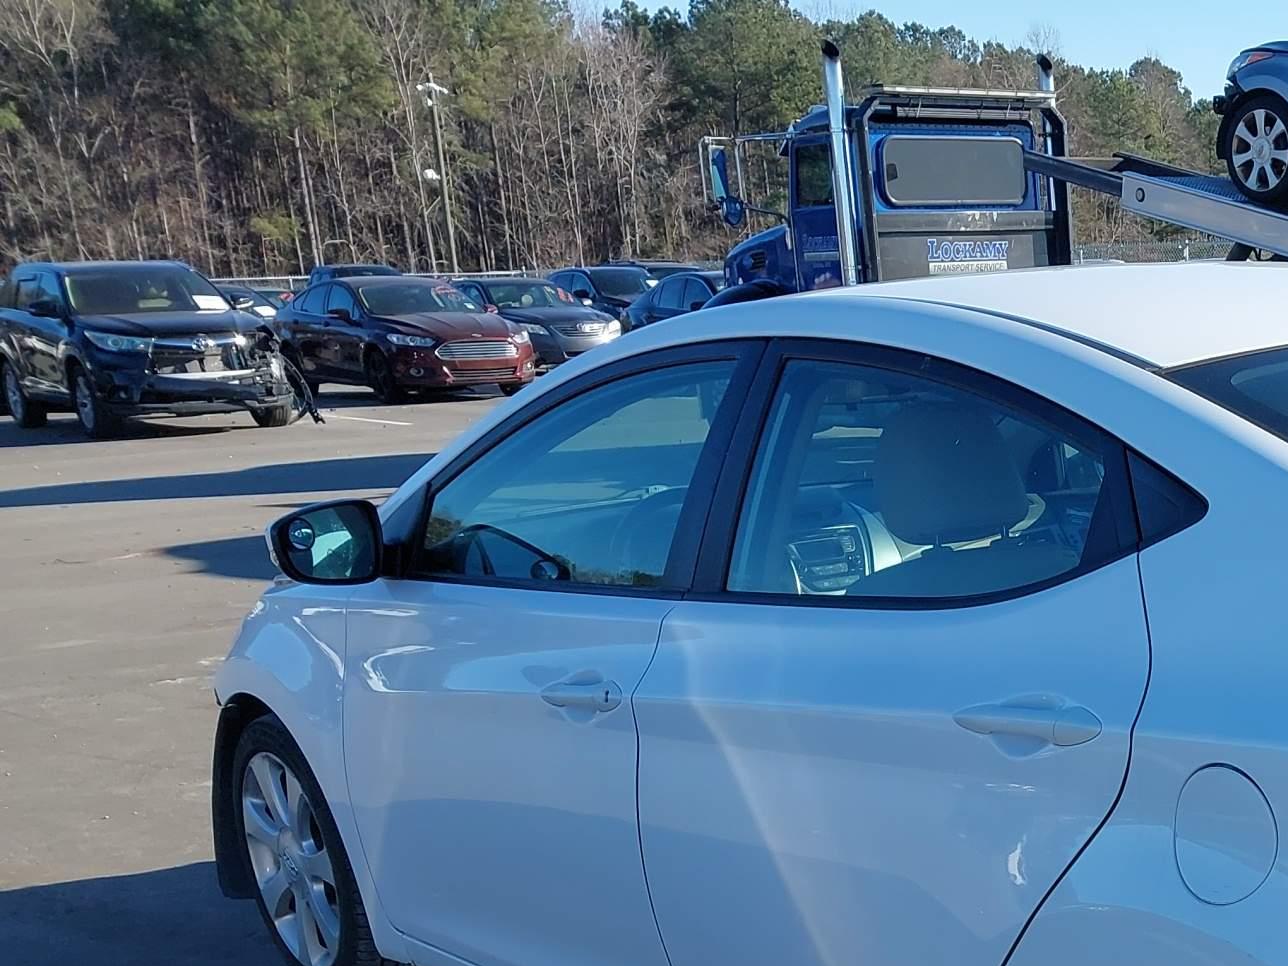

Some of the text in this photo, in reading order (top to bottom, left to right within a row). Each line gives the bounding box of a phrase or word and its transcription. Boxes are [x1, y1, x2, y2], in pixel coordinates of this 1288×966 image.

[927, 238, 1009, 261] LOCKAMY
[933, 262, 1005, 273] TRANSPORT SERVICE
